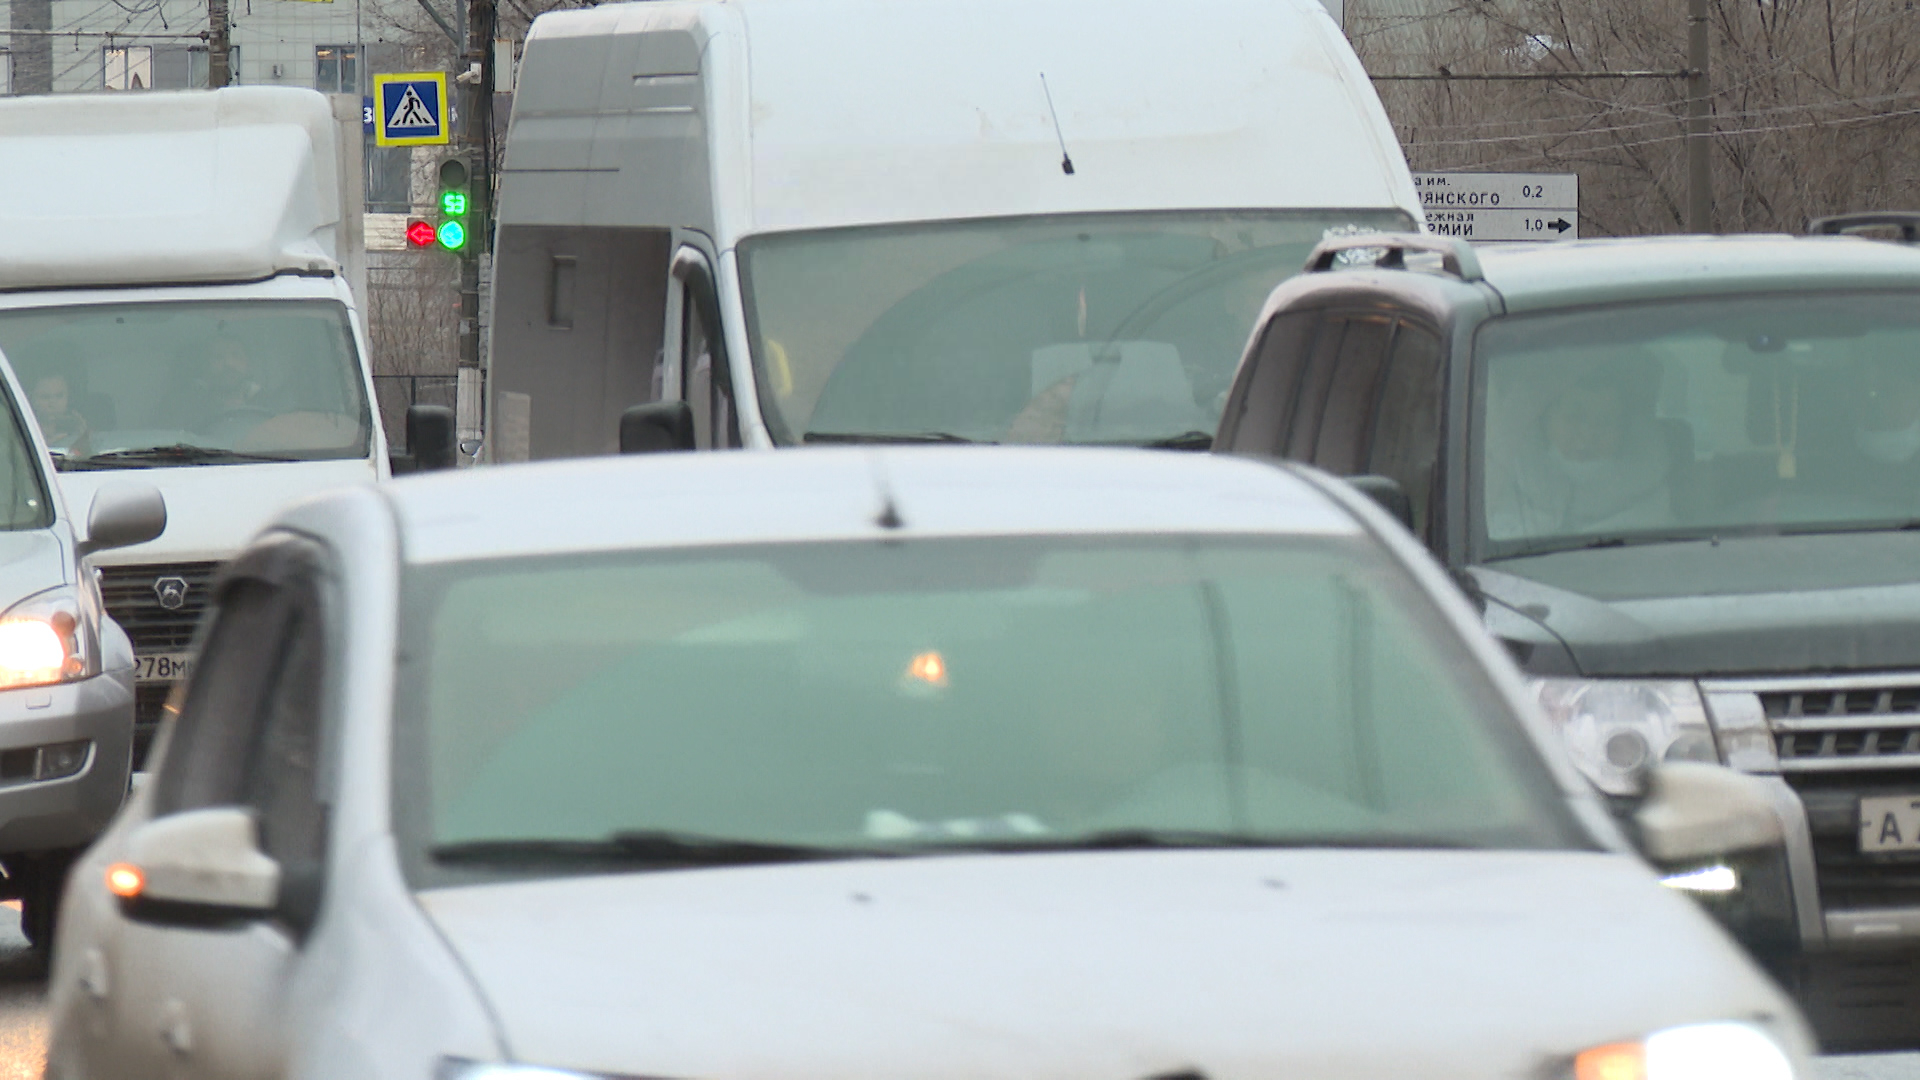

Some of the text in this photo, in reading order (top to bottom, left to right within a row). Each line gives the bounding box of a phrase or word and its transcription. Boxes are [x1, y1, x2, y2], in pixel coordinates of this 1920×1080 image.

[1427, 177, 1451, 186] им.
[1522, 185, 1544, 198] 0.2
[444, 194, 466, 214] 53
[1525, 219, 1544, 231] 1.0
